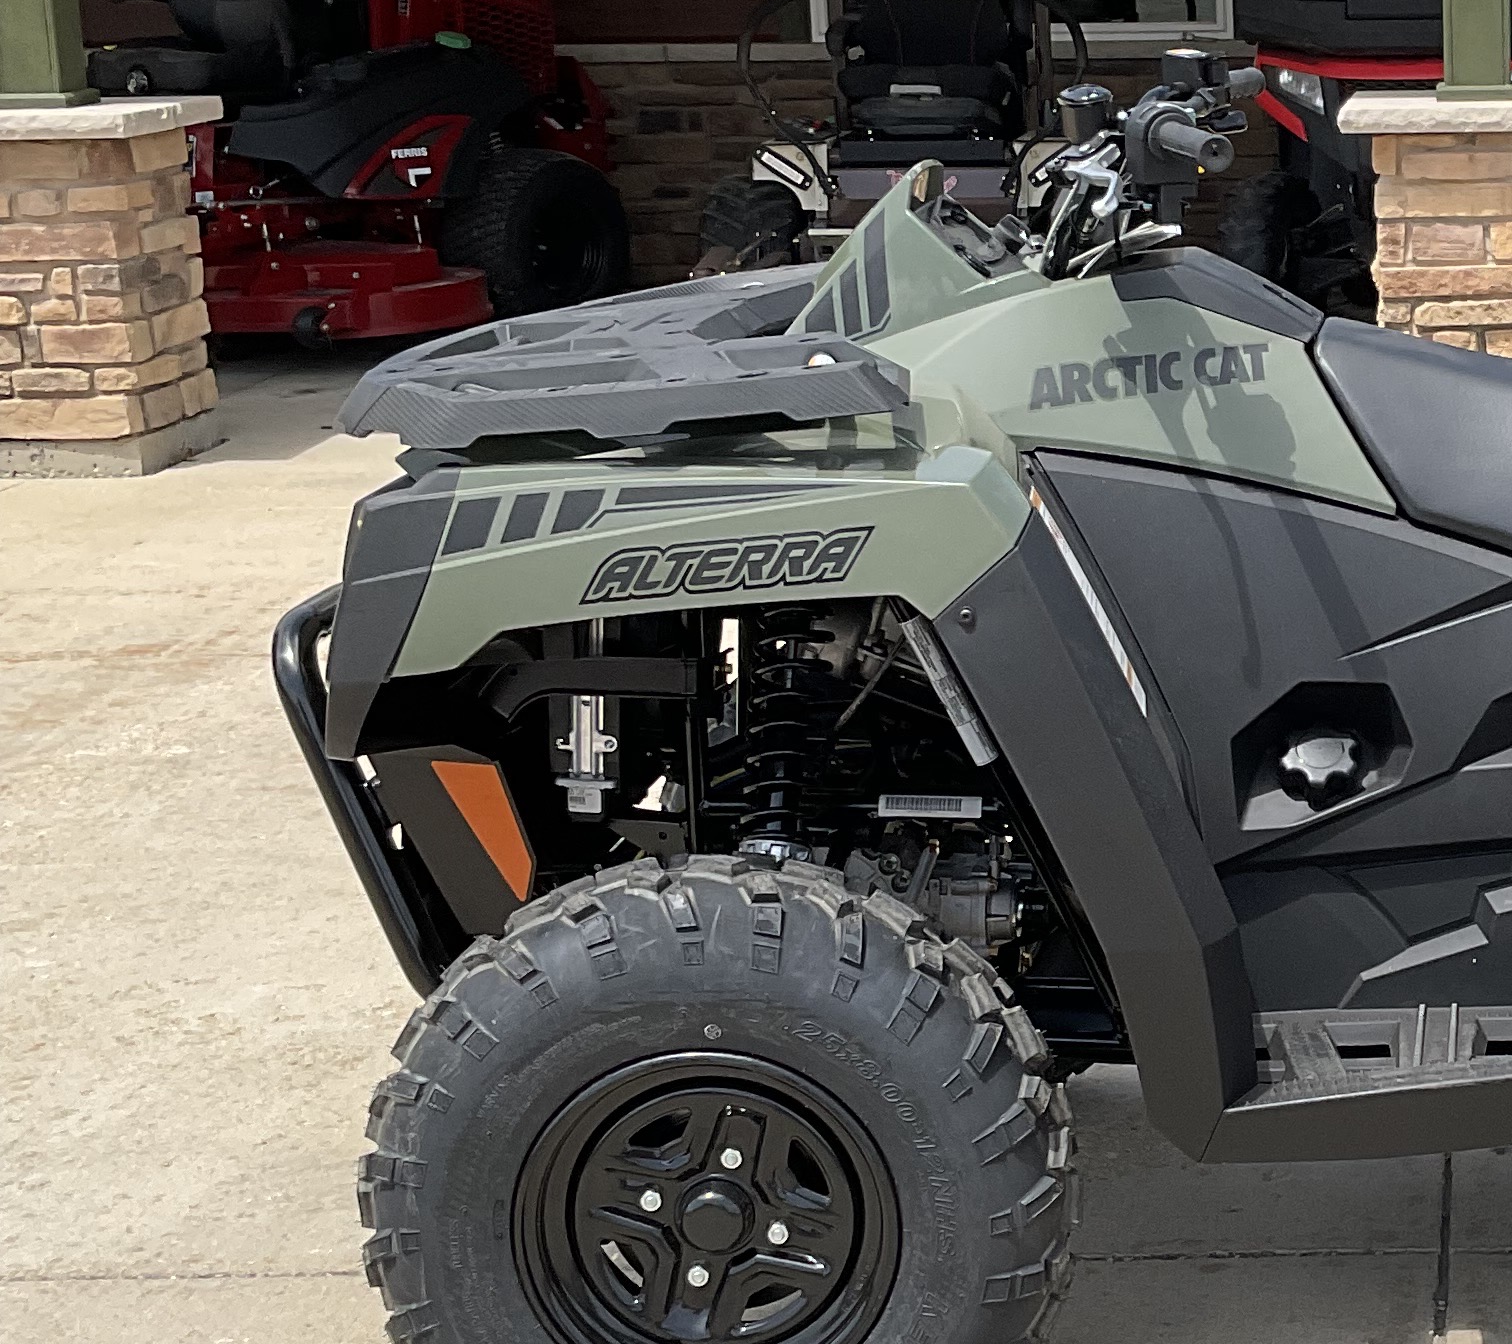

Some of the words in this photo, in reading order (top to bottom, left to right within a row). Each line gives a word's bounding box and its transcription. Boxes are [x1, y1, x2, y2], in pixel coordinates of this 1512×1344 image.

[391, 147, 428, 159] FERRIS
[1029, 351, 1184, 411] ARCTIC
[1193, 343, 1270, 387] CAT
[587, 532, 868, 600] ALTERRA
